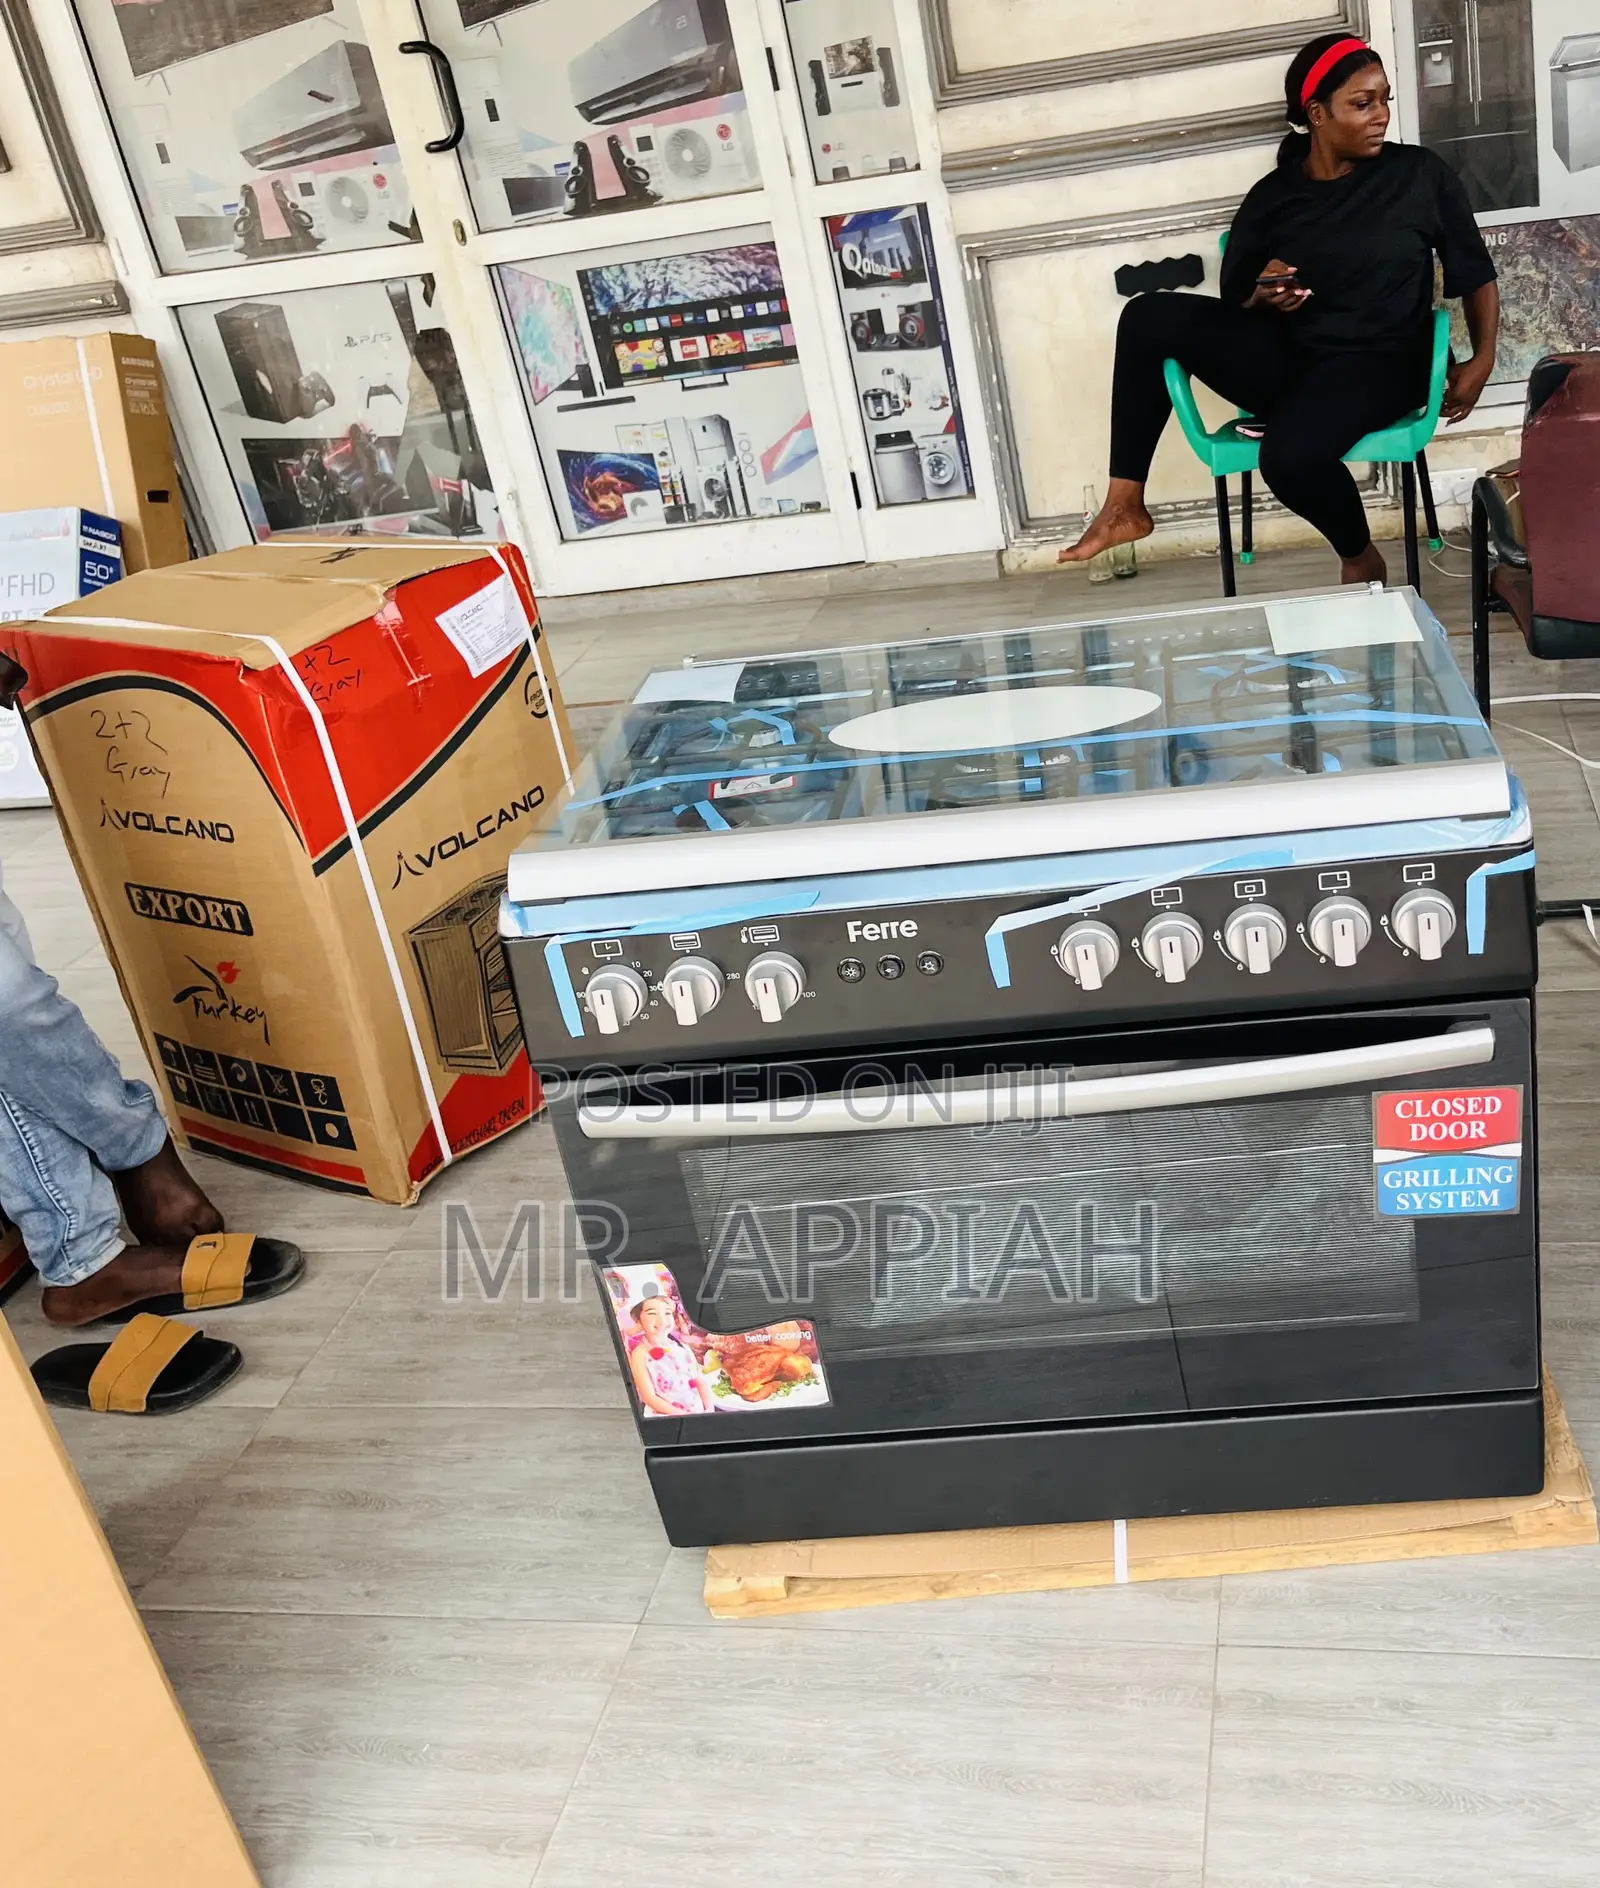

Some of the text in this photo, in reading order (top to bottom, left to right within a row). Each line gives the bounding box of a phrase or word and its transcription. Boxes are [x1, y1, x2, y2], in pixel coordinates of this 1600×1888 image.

[721, 142, 734, 151] LG
[1482, 232, 1508, 247] NG
[359, 332, 392, 344] PS5
[89, 526, 117, 541] NASCO
[89, 709, 168, 755] 2+2
[113, 808, 235, 844] VOLCANO
[414, 785, 545, 868] VOLCANO
[129, 886, 245, 932] EXPORT
[846, 919, 919, 943] Ferre
[631, 961, 641, 969] 10
[643, 970, 653, 978] 20
[726, 972, 741, 980] 280
[649, 984, 658, 992] 30
[640, 1013, 650, 1021] 50
[1395, 1096, 1502, 1119] CLOSED
[1409, 1120, 1487, 1141] DOOR
[1383, 1165, 1513, 1189] GRILLING
[1396, 1189, 1501, 1210] SYSTEM
[745, 1333, 772, 1343] better
